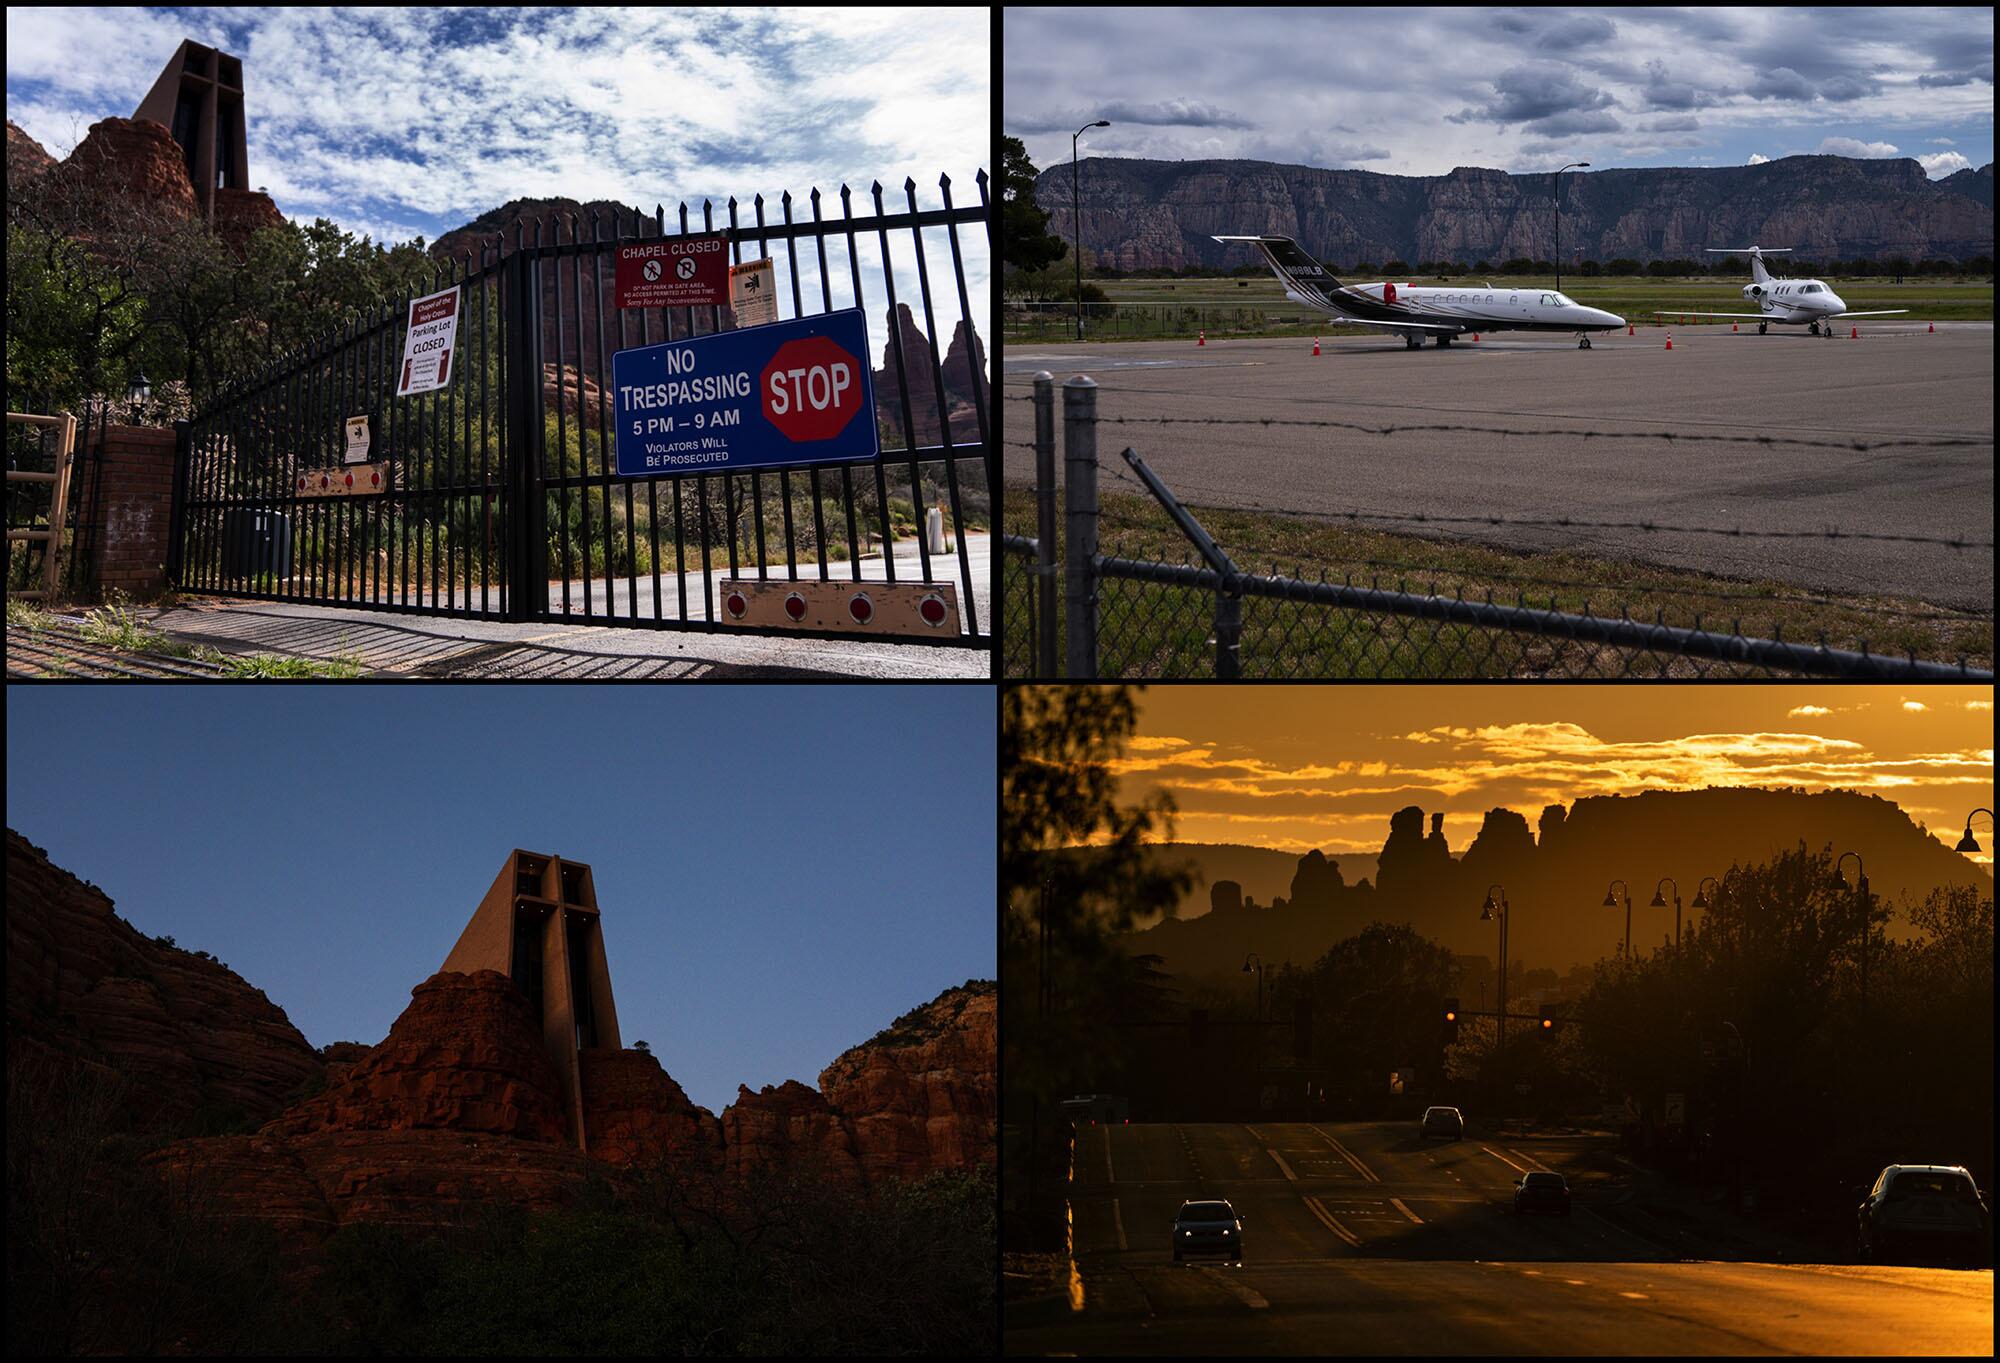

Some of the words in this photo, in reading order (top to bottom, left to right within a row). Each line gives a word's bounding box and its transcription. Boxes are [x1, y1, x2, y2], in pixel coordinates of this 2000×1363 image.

[622, 246, 667, 259] CHAPEL
[671, 240, 721, 255] CLOSED
[417, 301, 435, 313] Chapel
[435, 299, 442, 307] of
[442, 297, 451, 305] the
[627, 299, 641, 307] Sorry
[654, 298, 665, 306] Any
[420, 312, 431, 322] Holy
[431, 309, 447, 319] Cross
[412, 325, 438, 338] Parking
[439, 321, 451, 331] Lot
[413, 337, 445, 355] CLOSED
[667, 349, 695, 375] NO
[620, 371, 751, 411] TRESPASSING
[770, 362, 851, 415] STOP
[633, 421, 643, 436] 5
[648, 417, 674, 434] PM
[694, 413, 705, 429] 9
[710, 409, 741, 426] AM
[646, 440, 699, 454] VIOLATORS
[701, 437, 728, 448] WILL
[646, 455, 661, 466] BE
[663, 451, 729, 465] PROSECUTED
